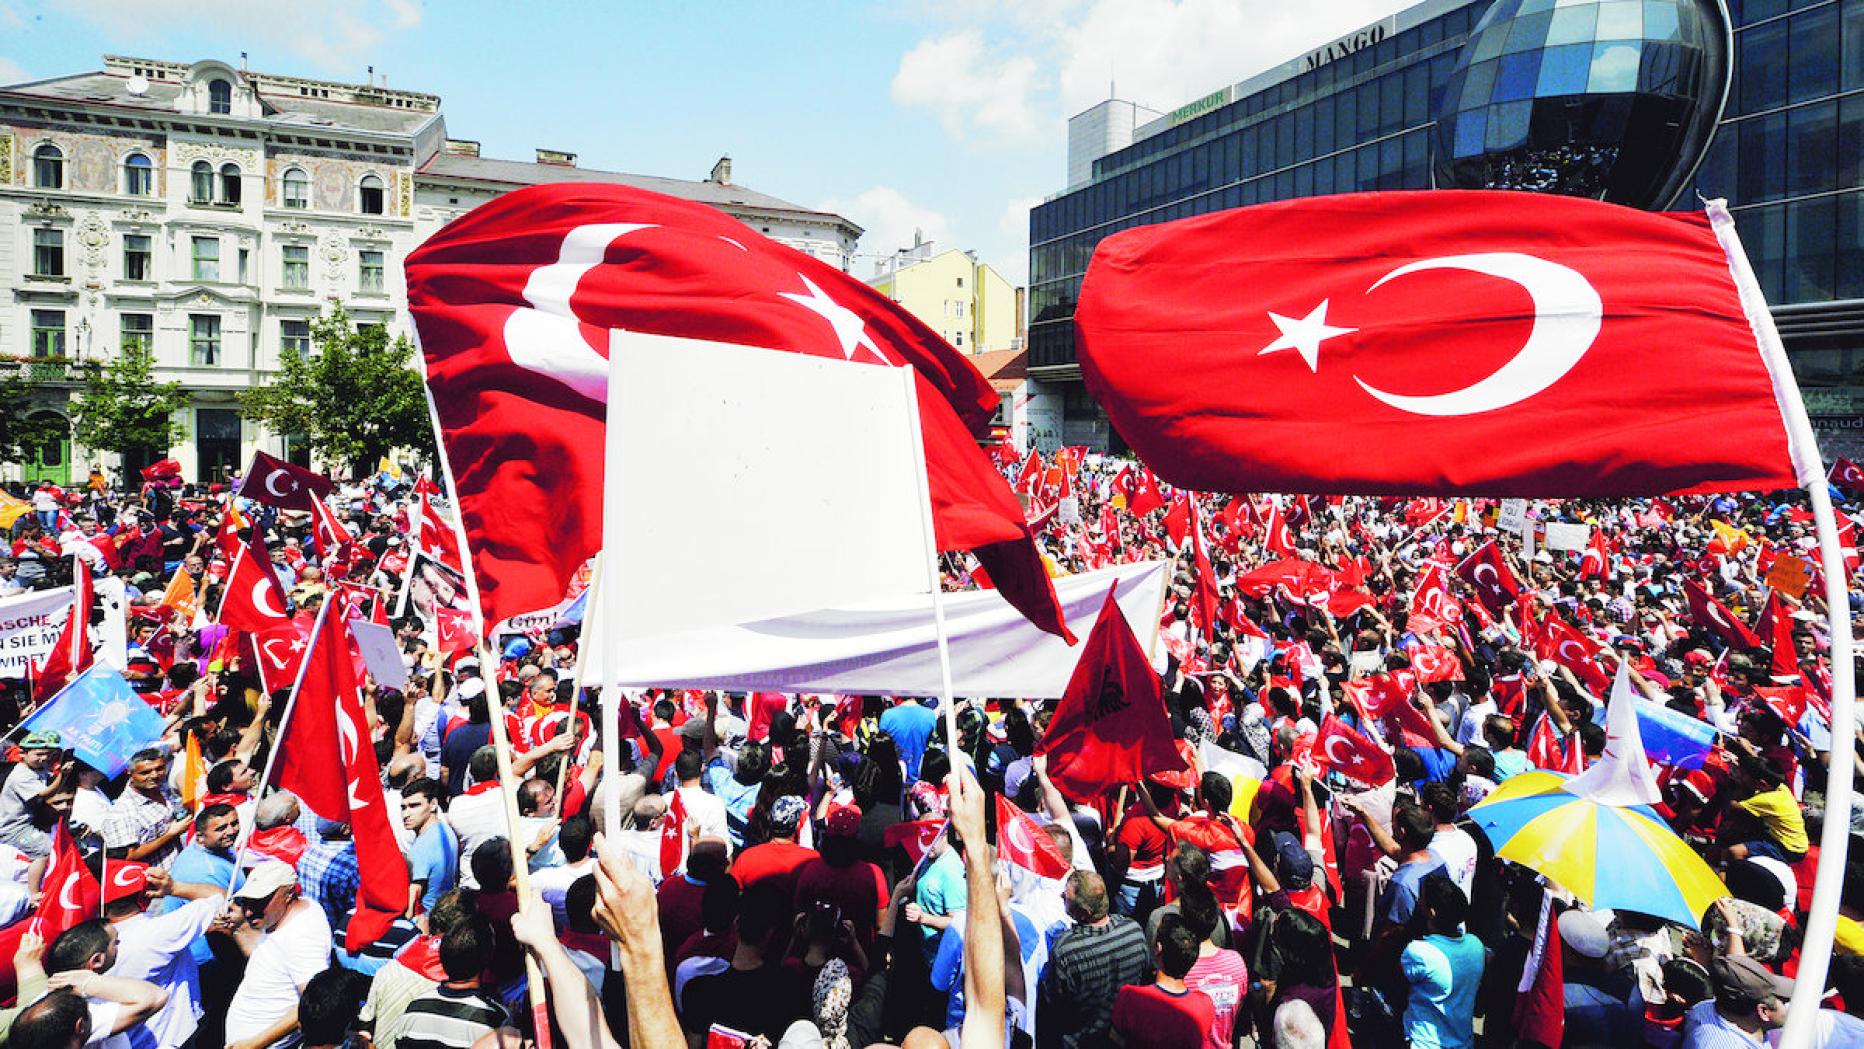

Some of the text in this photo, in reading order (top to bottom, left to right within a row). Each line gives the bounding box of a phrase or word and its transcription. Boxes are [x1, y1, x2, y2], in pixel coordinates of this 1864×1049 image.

[1306, 25, 1385, 69] MANGO
[1172, 90, 1224, 123] MERKUR
[10, 633, 37, 649] SIE
